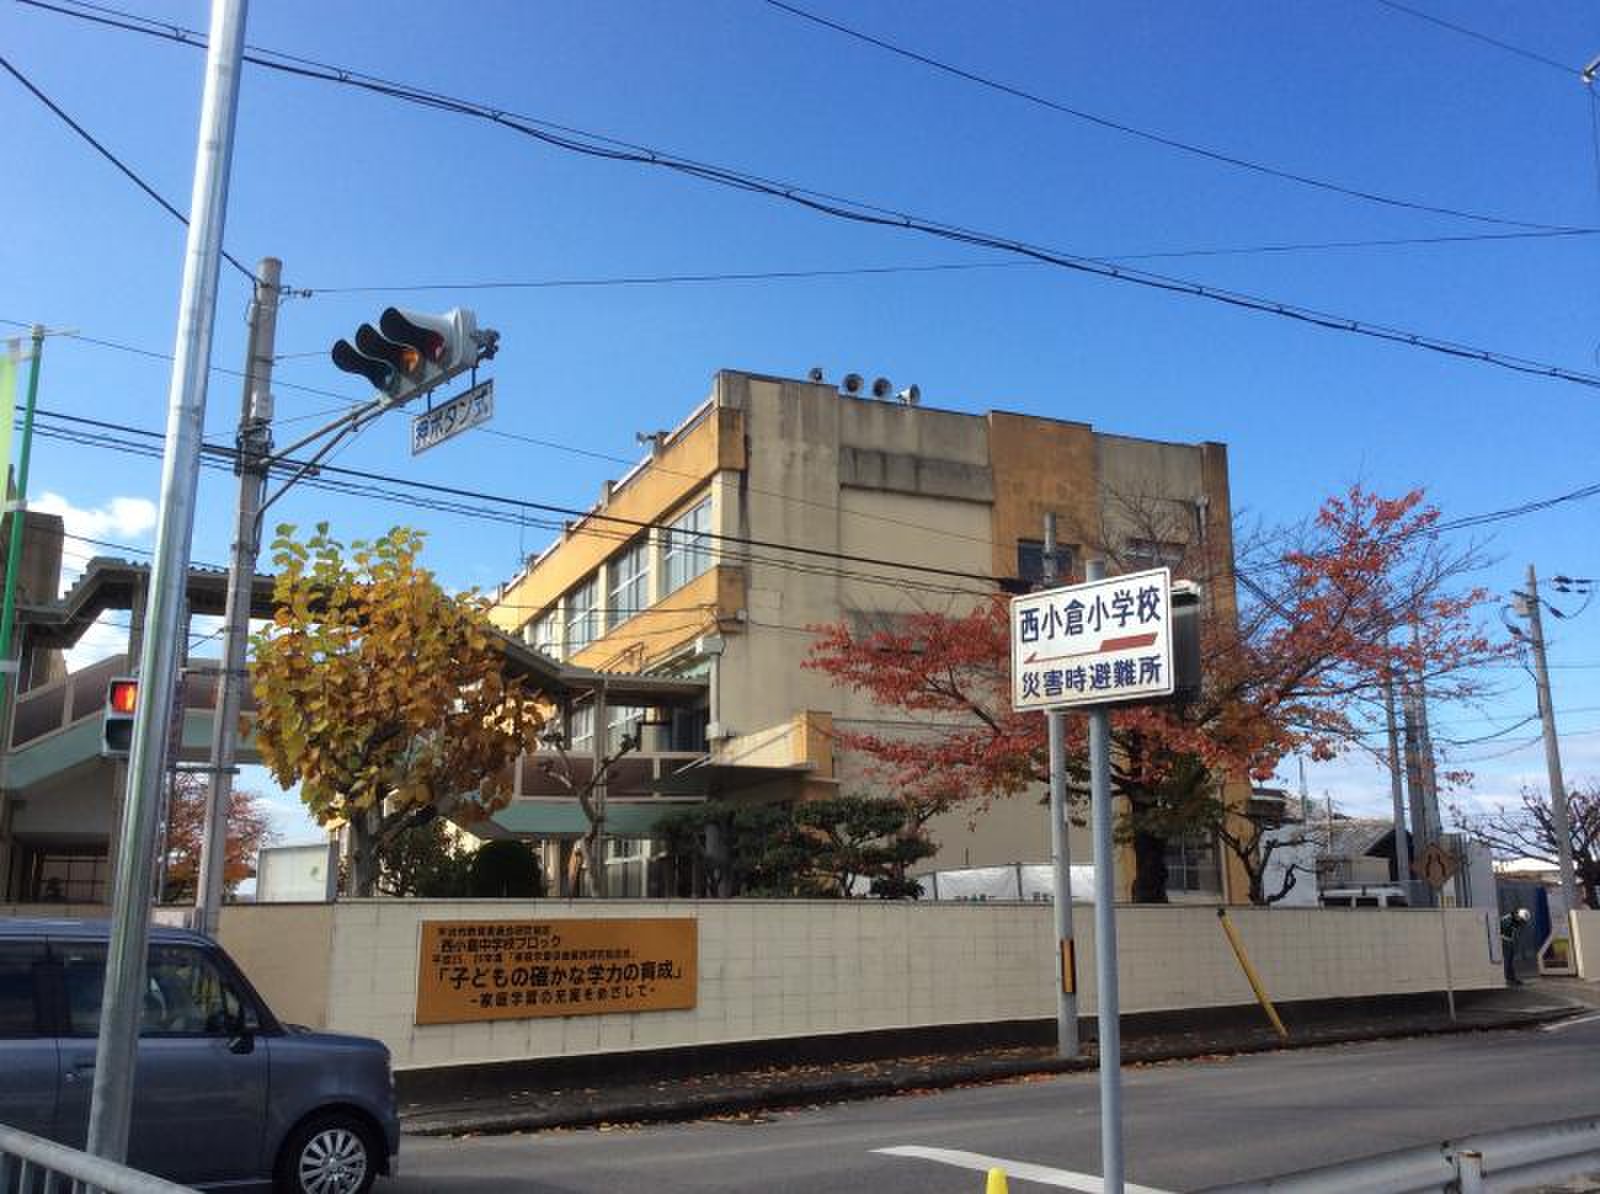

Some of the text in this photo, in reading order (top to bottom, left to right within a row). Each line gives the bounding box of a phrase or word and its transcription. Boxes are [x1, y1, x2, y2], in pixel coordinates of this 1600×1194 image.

[1020, 585, 1162, 643] 西小倉小学校
[1022, 653, 1162, 699] 災害時避難所
